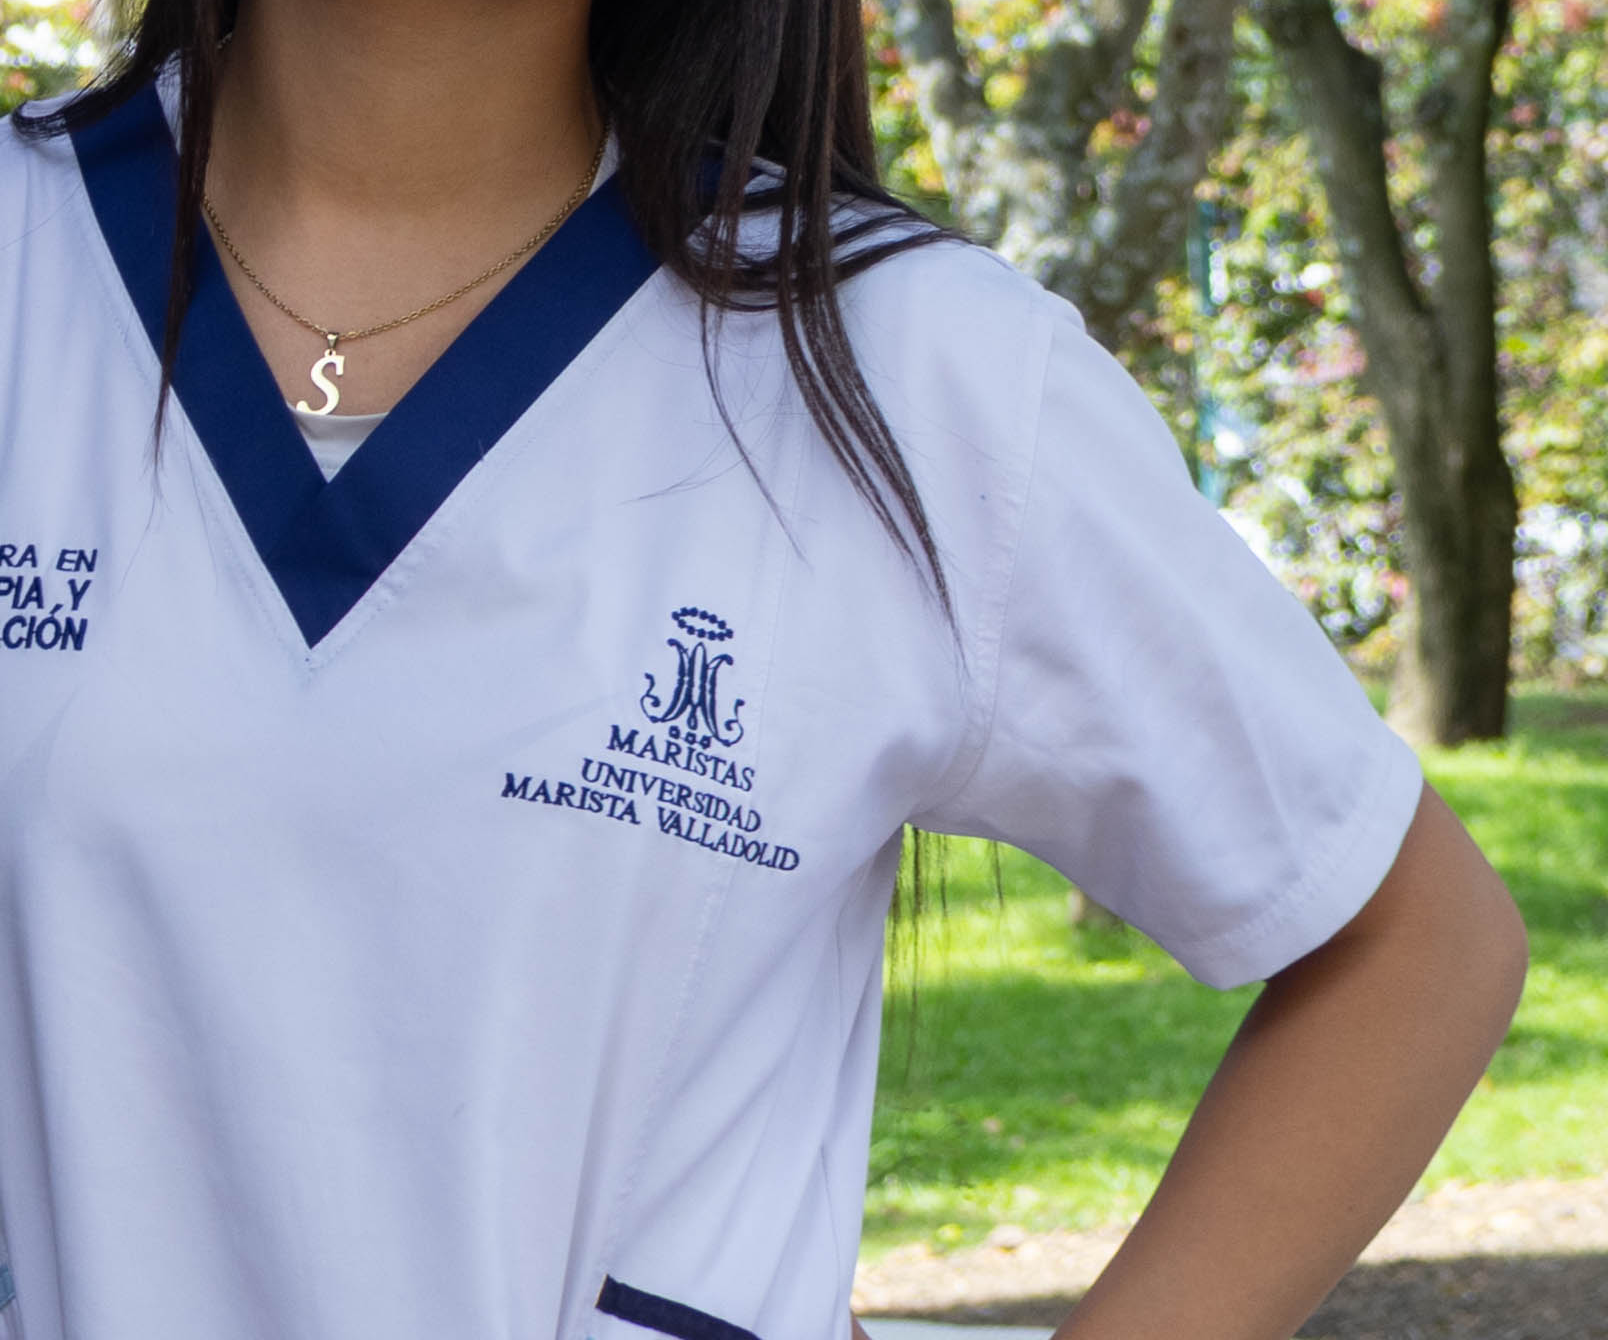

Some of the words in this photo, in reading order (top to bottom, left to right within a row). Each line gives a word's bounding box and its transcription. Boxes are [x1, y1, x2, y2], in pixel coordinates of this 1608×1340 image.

[56, 549, 97, 572] EN
[67, 579, 92, 610] Y
[607, 725, 755, 791] MARISTAS
[501, 773, 641, 825] MARISTA
[657, 806, 800, 871] VALLADOLID
[581, 758, 761, 833] UNIVERSIDAD
